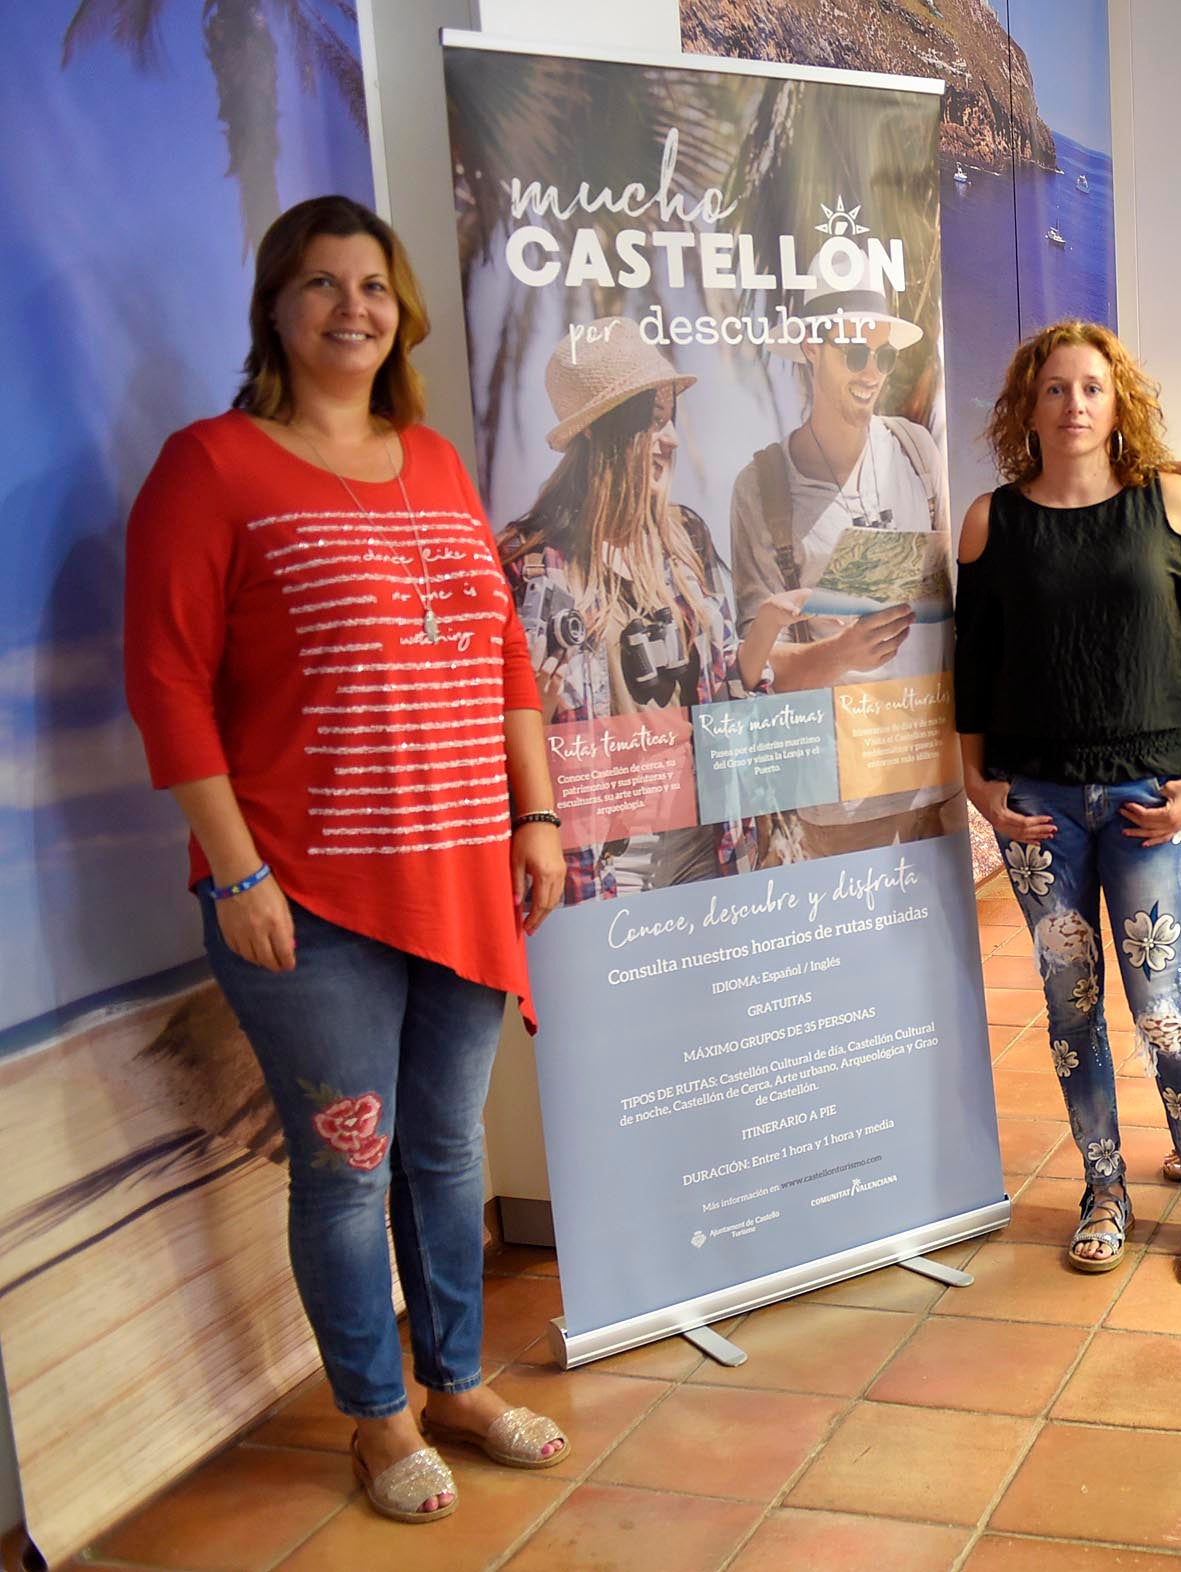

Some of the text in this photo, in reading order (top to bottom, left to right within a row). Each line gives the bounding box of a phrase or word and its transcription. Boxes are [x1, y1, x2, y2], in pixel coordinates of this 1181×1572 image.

[511, 127, 738, 224] mucho
[568, 306, 877, 364] por descubrir
[422, 548, 466, 562] like
[463, 582, 477, 596] is
[839, 692, 881, 719] Rutas
[548, 725, 678, 761] Rutas temáticas
[699, 713, 744, 738] Rutas
[557, 774, 590, 784] Conoce
[630, 763, 641, 773] de
[713, 760, 727, 770] del
[562, 782, 610, 797] patrimonio
[615, 790, 632, 800] arte
[632, 785, 663, 796] urbano
[607, 856, 919, 949] Conoce, descubre y disfruta
[608, 906, 929, 985] Consulta nuestros horarios de rutas guiadas
[712, 956, 841, 994] IDIOMA: Español / Inglés
[747, 992, 812, 1017] GRATUITAS
[683, 1006, 876, 1063] MÁXIMO GRUPOS DE 35 PERSONAS
[619, 1114, 633, 1127] de
[673, 1091, 724, 1112] Castellón
[726, 1087, 739, 1100] de
[774, 1071, 798, 1087] Arte
[840, 1045, 905, 1069] Arqueológica
[905, 1043, 913, 1055] y
[914, 1037, 939, 1050] Grao
[621, 1091, 656, 1110] TIPOS
[657, 1086, 674, 1101] DE
[675, 1076, 718, 1096] RUTAS:
[719, 1063, 769, 1085] Castellón
[770, 1051, 813, 1072] Cultural
[813, 1050, 826, 1061] de
[847, 1030, 894, 1052] Castellón
[894, 1021, 936, 1041] Cultural
[755, 1094, 768, 1106] de
[741, 1104, 837, 1140] ITINERARIO A PIE
[682, 1118, 895, 1186] DURACIÓN: Entre 1 hora y 1 hora y media
[702, 1154, 882, 1212] Más información en www.castellonturismo.com
[810, 1174, 898, 1207] COMUNITAT VALENCIANA
